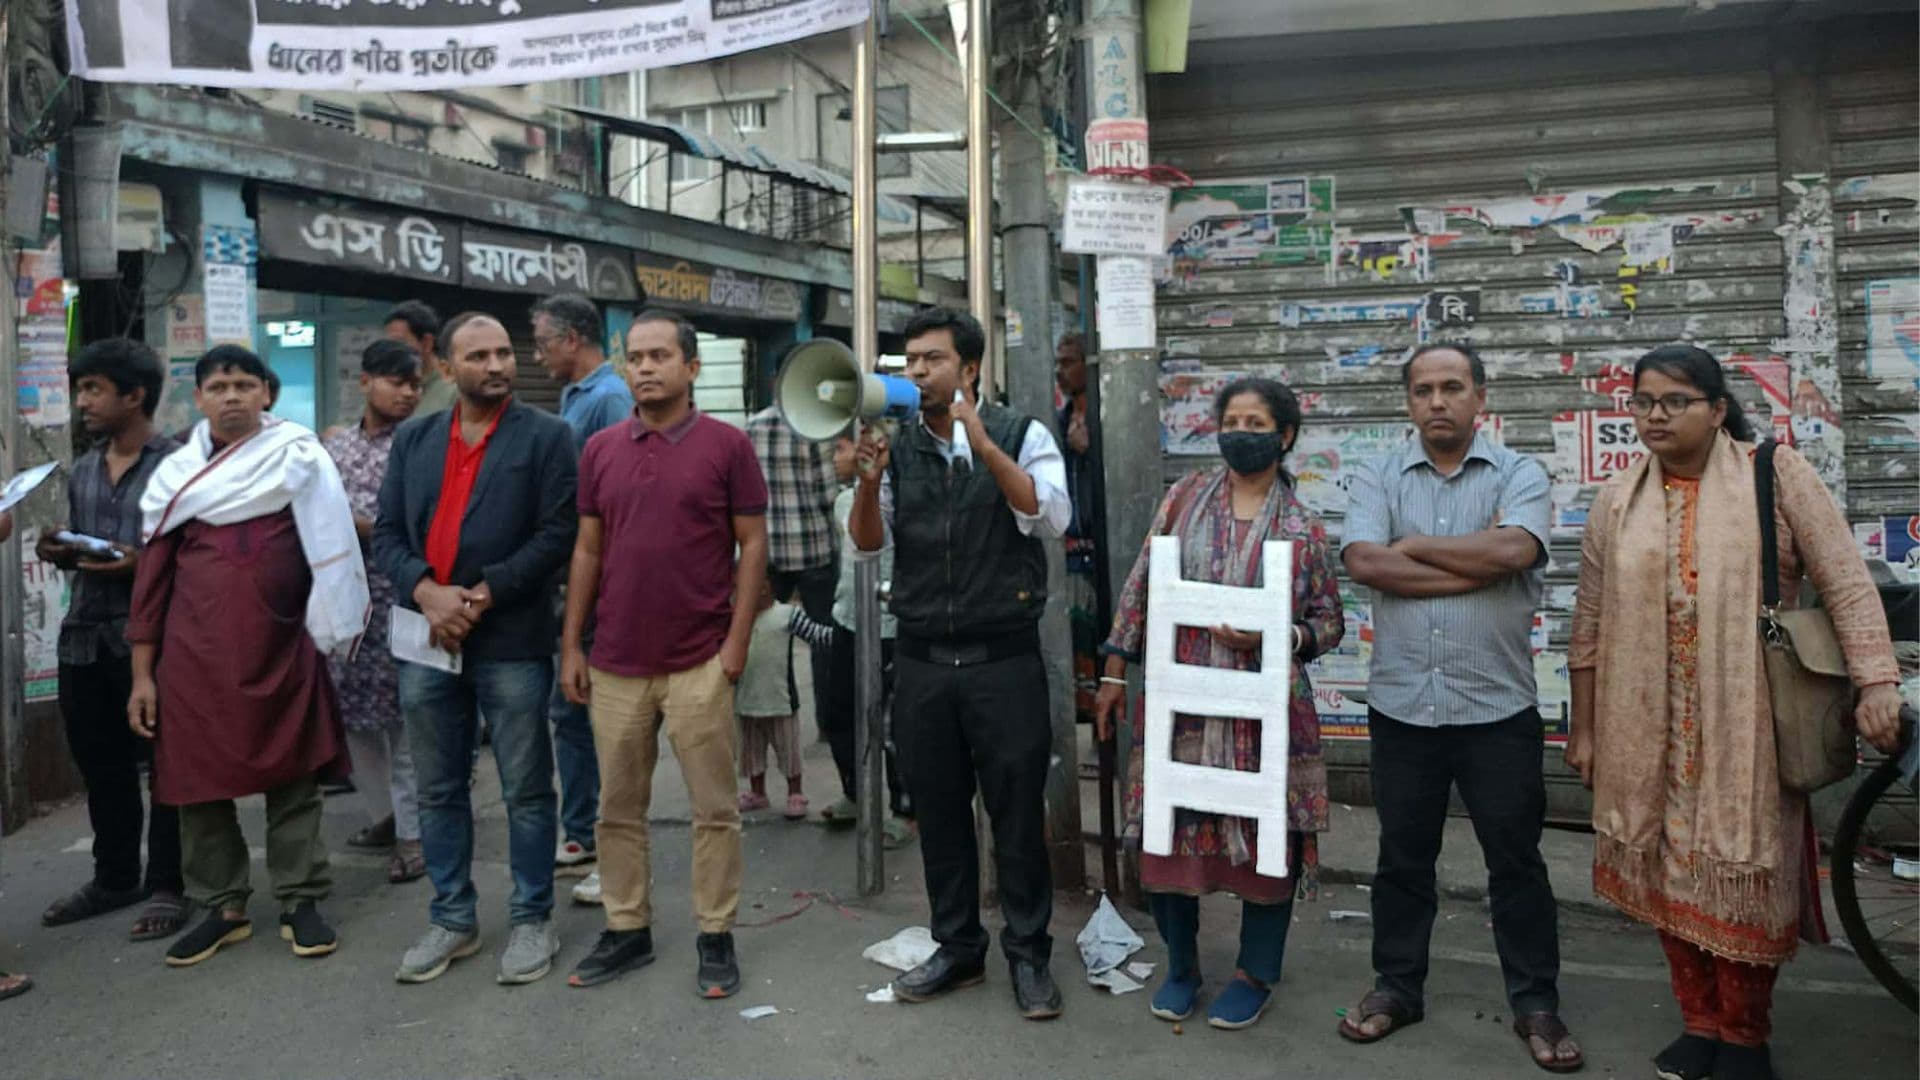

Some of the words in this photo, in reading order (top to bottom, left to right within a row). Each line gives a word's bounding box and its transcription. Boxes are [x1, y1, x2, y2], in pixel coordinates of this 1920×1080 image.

[267, 42, 344, 75] ধানের
[352, 39, 401, 73] শীষ
[409, 39, 498, 76] প্রতীকে
[1598, 423, 1638, 445] SS
